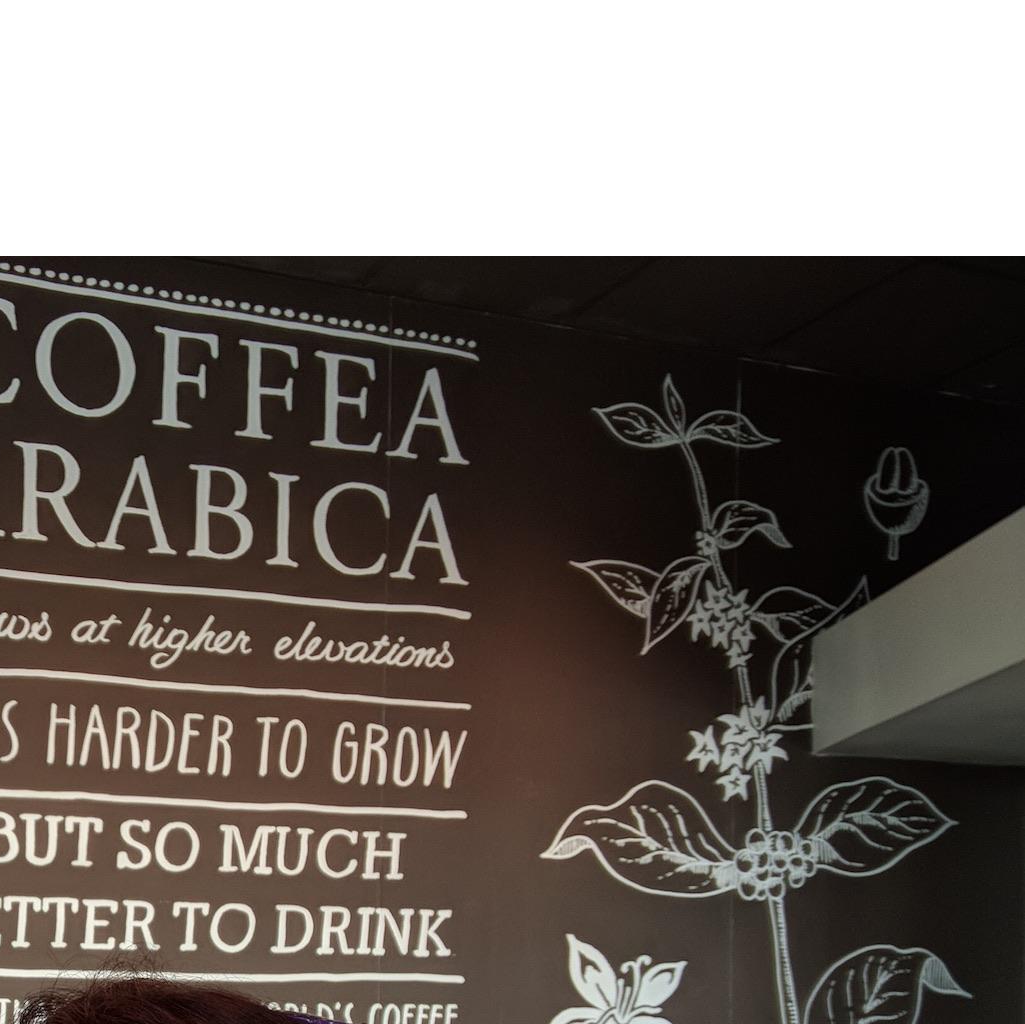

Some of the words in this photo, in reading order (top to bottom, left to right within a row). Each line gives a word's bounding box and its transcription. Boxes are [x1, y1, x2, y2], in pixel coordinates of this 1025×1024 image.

[70, 613, 122, 644] at
[127, 607, 253, 670] higher
[273, 620, 455, 669] elevations
[46, 702, 234, 778] HARDER
[256, 716, 308, 779] TO
[331, 721, 468, 789] GROW
[115, 818, 201, 873] SO
[217, 823, 408, 881] MUCH
[171, 900, 257, 954] TO
[269, 903, 453, 958] DRINK
